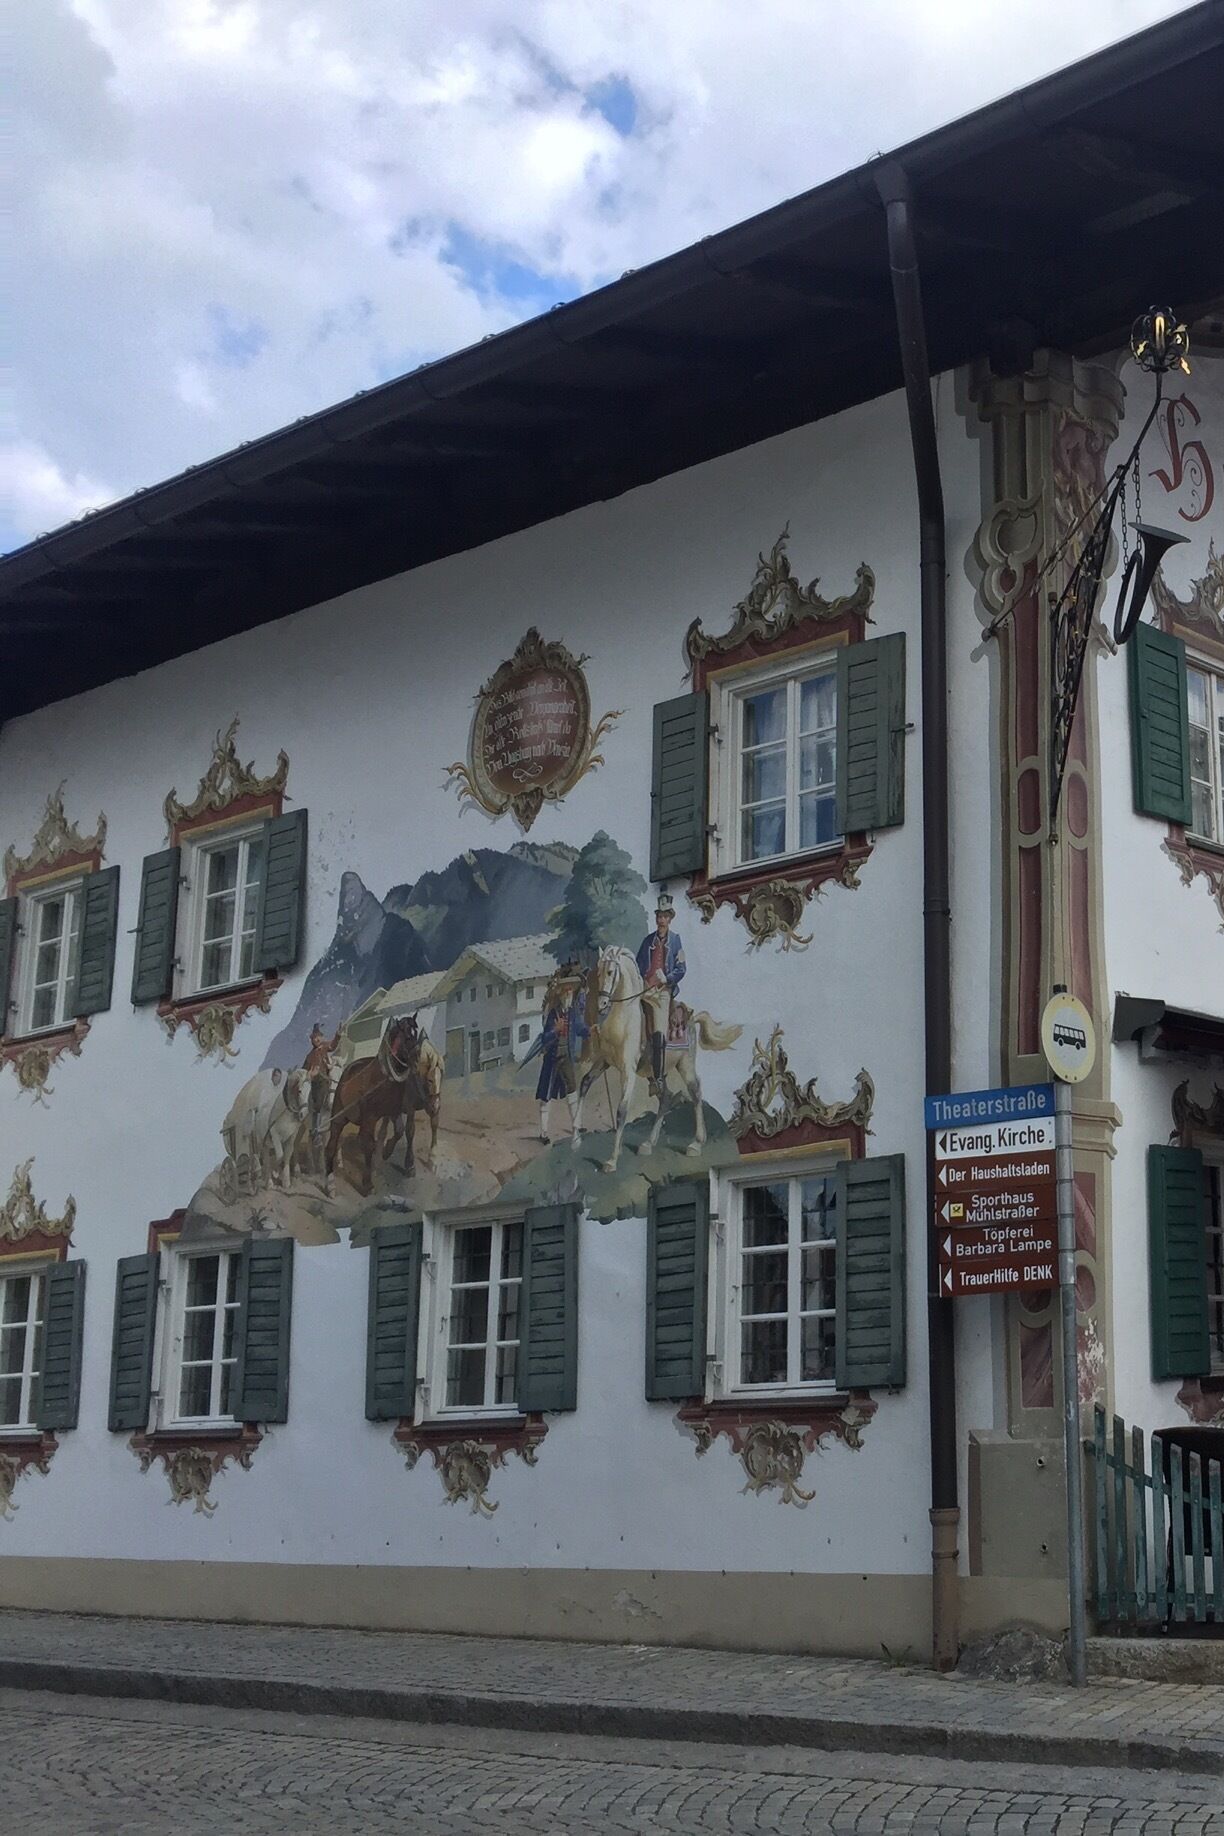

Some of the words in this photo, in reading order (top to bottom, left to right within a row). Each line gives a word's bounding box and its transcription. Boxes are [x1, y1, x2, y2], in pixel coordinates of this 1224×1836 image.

[932, 1090, 1046, 1121] Theaterstraße
[950, 1133, 995, 1154] Evang.
[998, 1125, 1045, 1148] Kirche
[949, 1168, 966, 1182] Der
[971, 1162, 1050, 1181] Haushaltsladen
[971, 1192, 1034, 1211] Sporthaus
[966, 1205, 1040, 1223] Mühlstraßer
[983, 1225, 1034, 1242] Töpferei
[956, 1242, 1005, 1257] Barbara
[1010, 1239, 1052, 1252] Lampe
[959, 1267, 1019, 1286] TrauerHilfe
[1023, 1264, 1053, 1281] DENK
